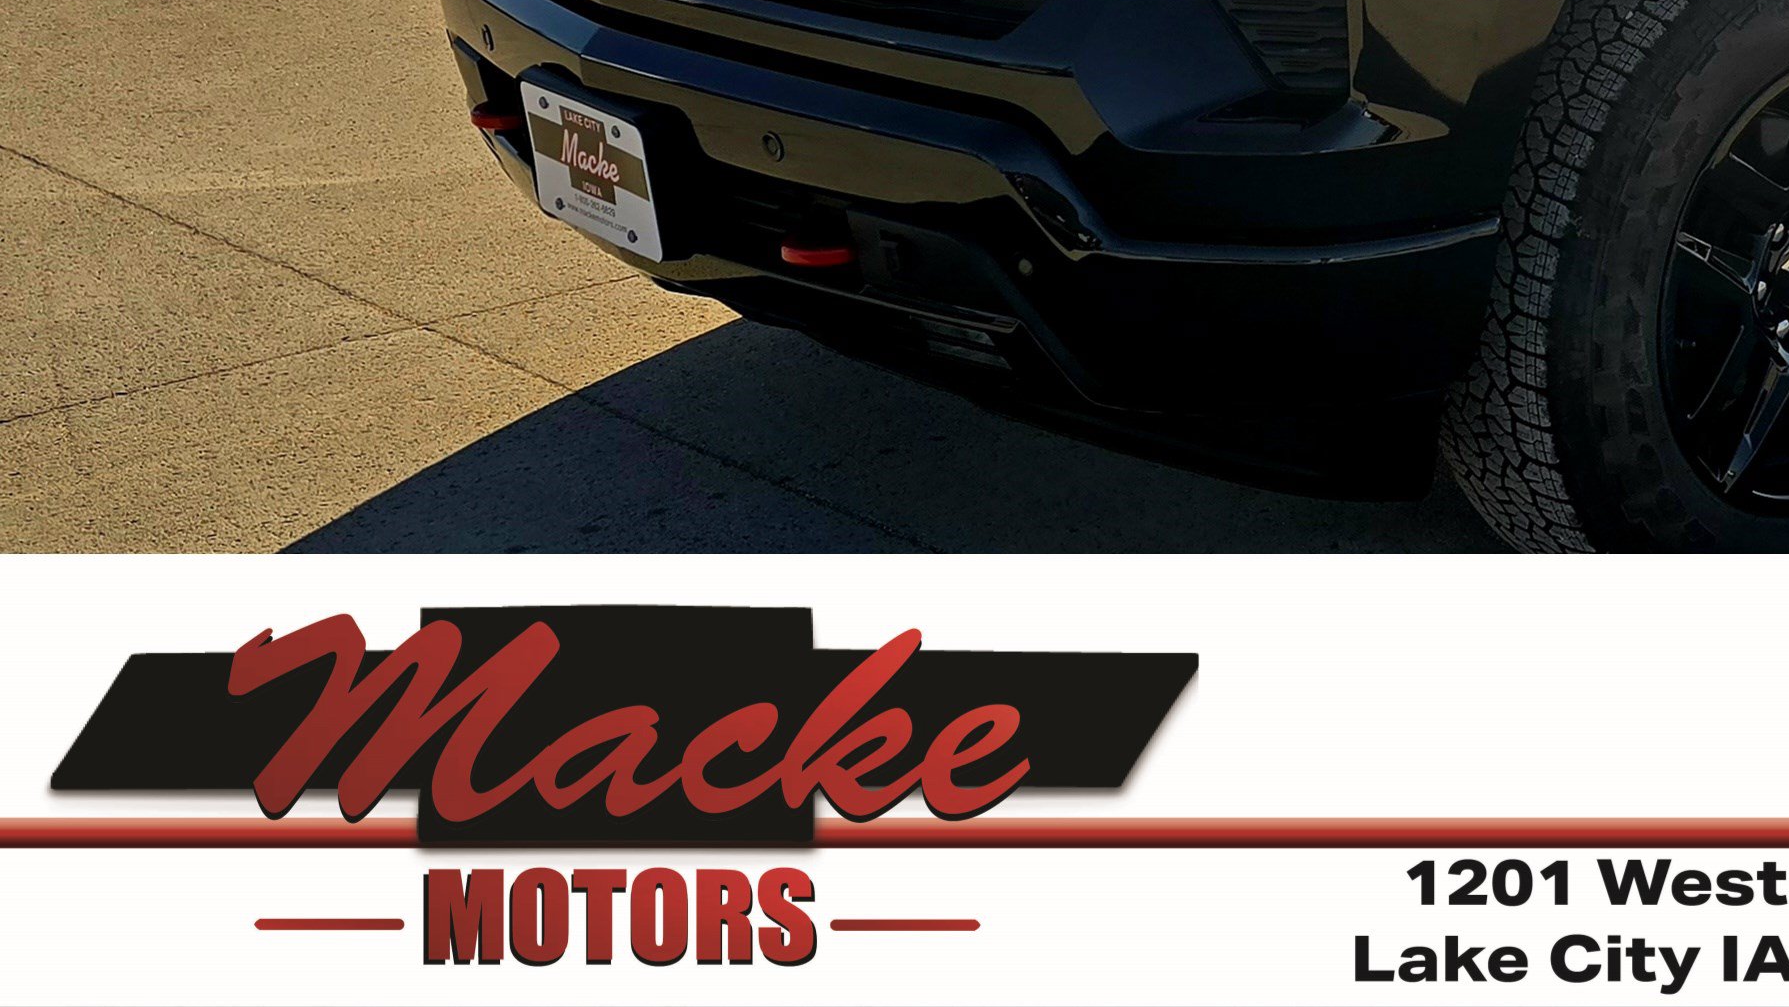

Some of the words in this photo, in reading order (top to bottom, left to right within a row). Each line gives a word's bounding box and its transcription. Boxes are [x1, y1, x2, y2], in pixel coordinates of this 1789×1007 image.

[564, 110, 583, 127] LAKE
[584, 118, 601, 133] CITY
[561, 128, 620, 183] Macke
[582, 180, 603, 198] IOWA
